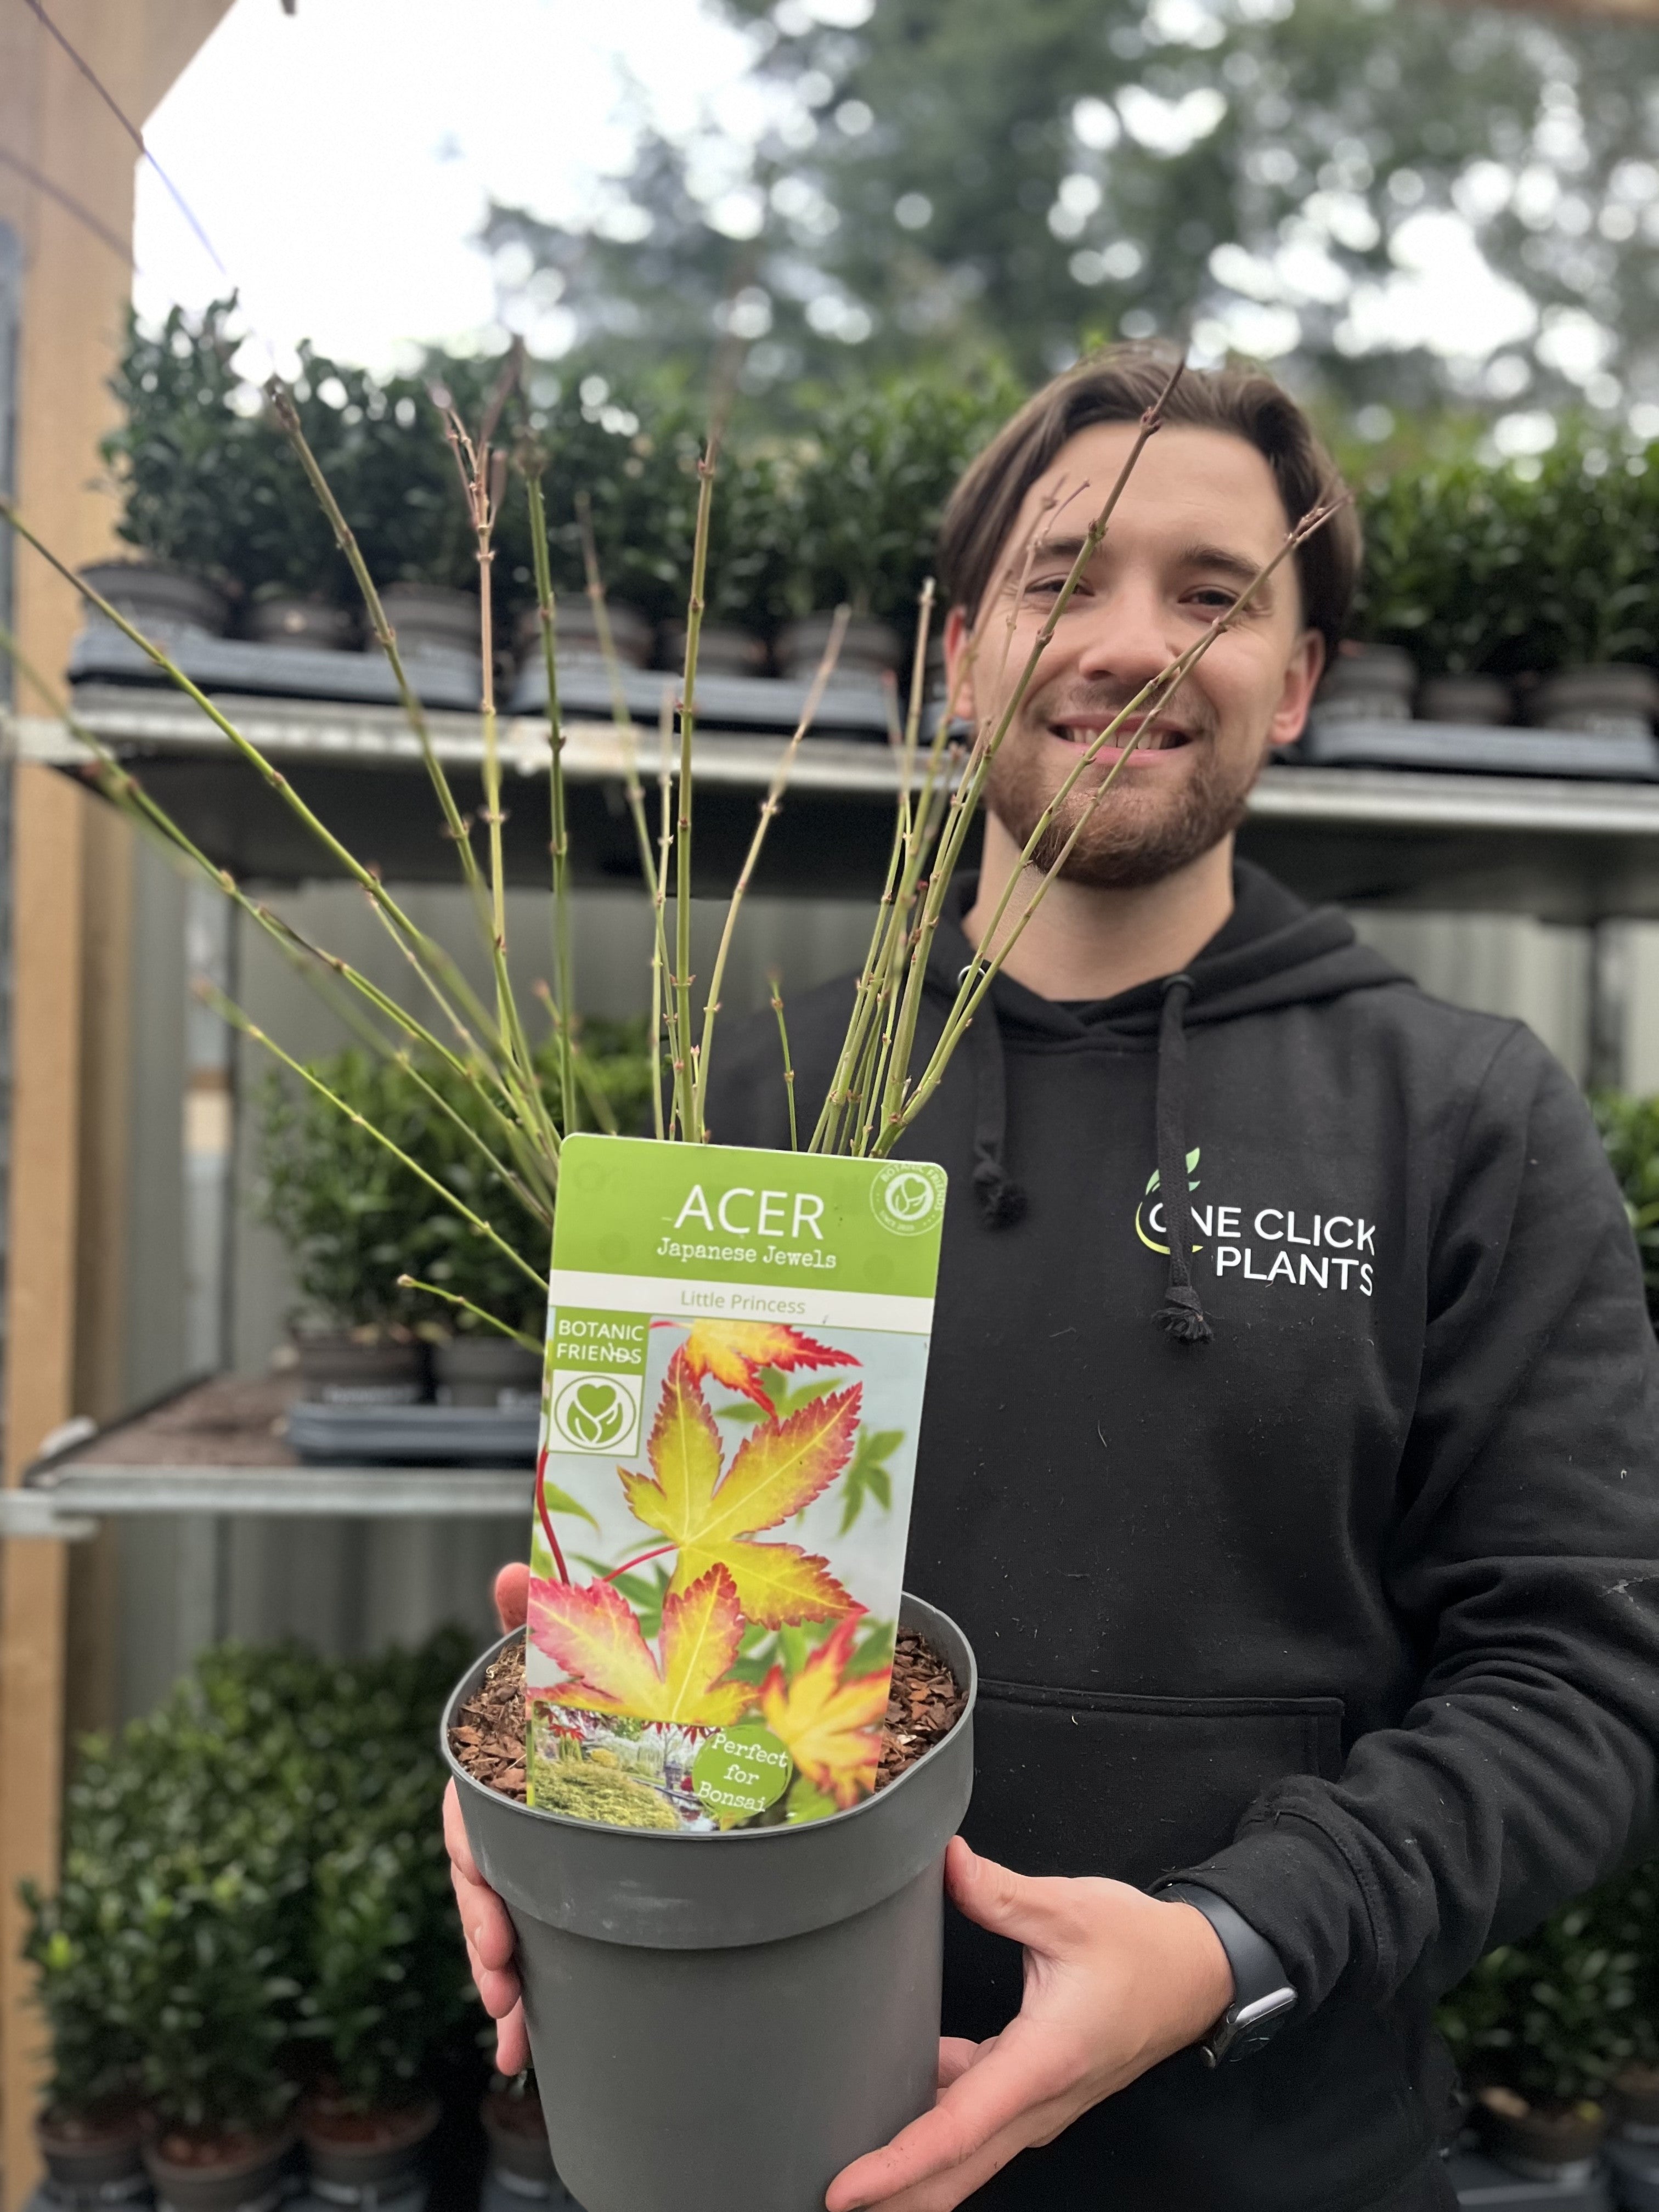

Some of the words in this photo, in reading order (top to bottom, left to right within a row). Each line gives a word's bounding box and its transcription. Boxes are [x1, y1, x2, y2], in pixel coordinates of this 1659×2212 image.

[674, 1184, 825, 1240] ACER
[1254, 1209, 1376, 1256] CLICK
[657, 1237, 757, 1262] Japanese
[763, 1245, 837, 1269] Jewels
[1216, 1246, 1374, 1296] PLANTS
[681, 1290, 725, 1308] Little
[731, 1294, 806, 1314] Princess
[558, 1319, 645, 1341] BOTANIC
[556, 1342, 642, 1364] FRIENDS
[711, 1733, 789, 1768] Perfect
[723, 1763, 760, 1785] for
[697, 1780, 766, 1812] Bonsai
